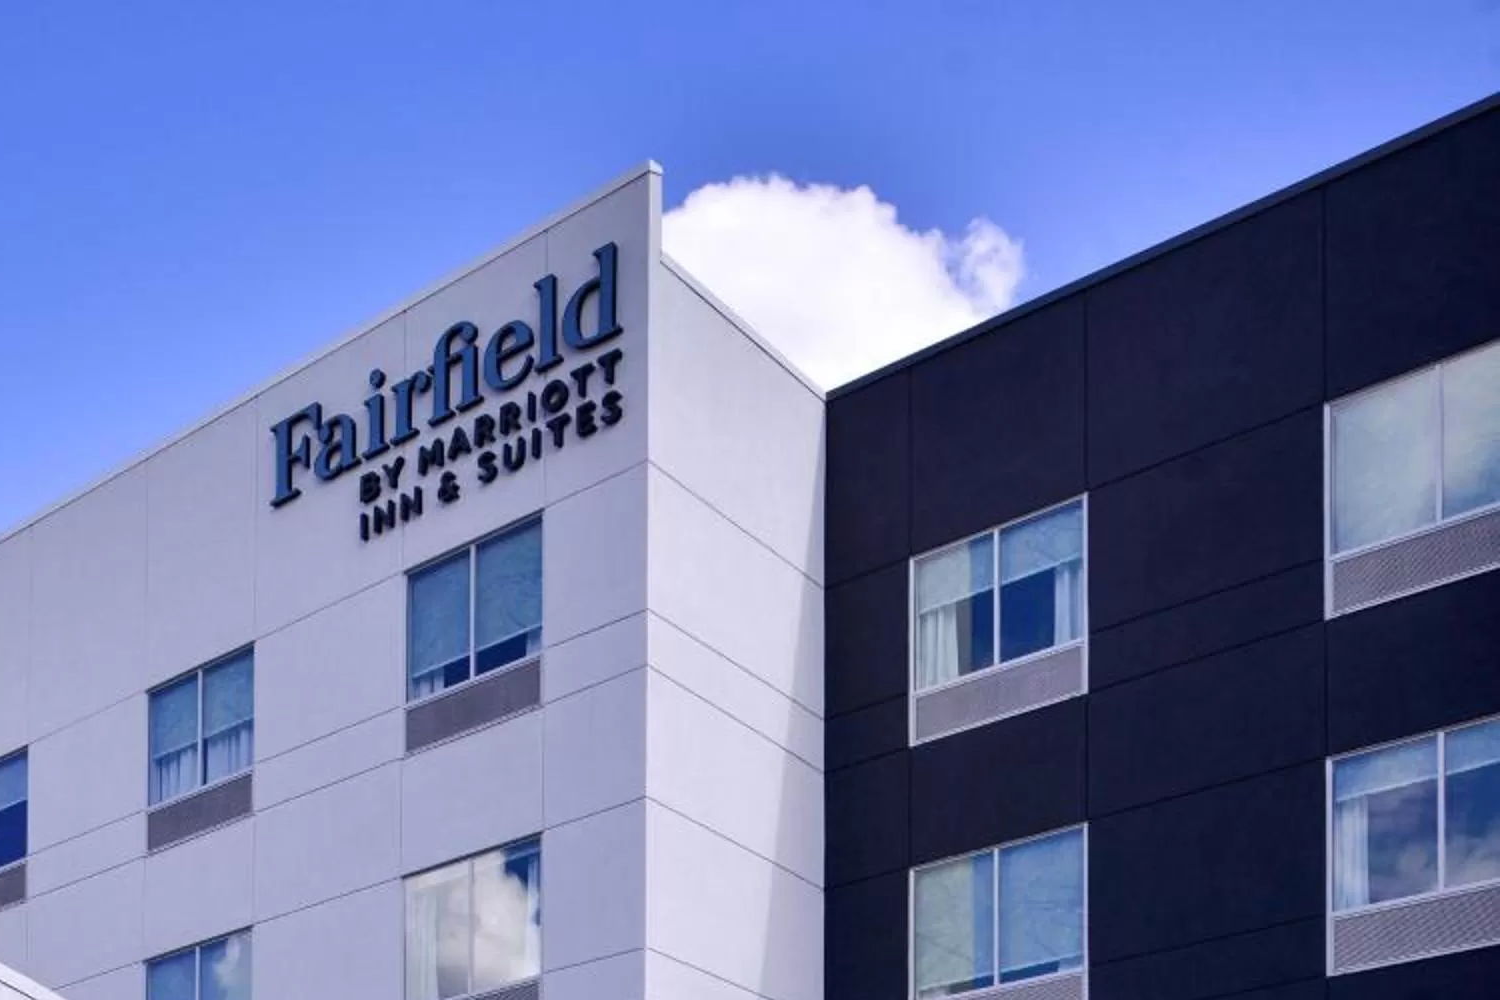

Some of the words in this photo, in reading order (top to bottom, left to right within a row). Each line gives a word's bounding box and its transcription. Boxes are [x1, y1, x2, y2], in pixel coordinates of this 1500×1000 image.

[269, 241, 624, 508] Fairfield
[359, 455, 405, 503] BY
[417, 348, 623, 476] MARRIOTT
[360, 485, 423, 541] INN
[437, 470, 460, 503] &
[477, 389, 623, 485] SUITES
